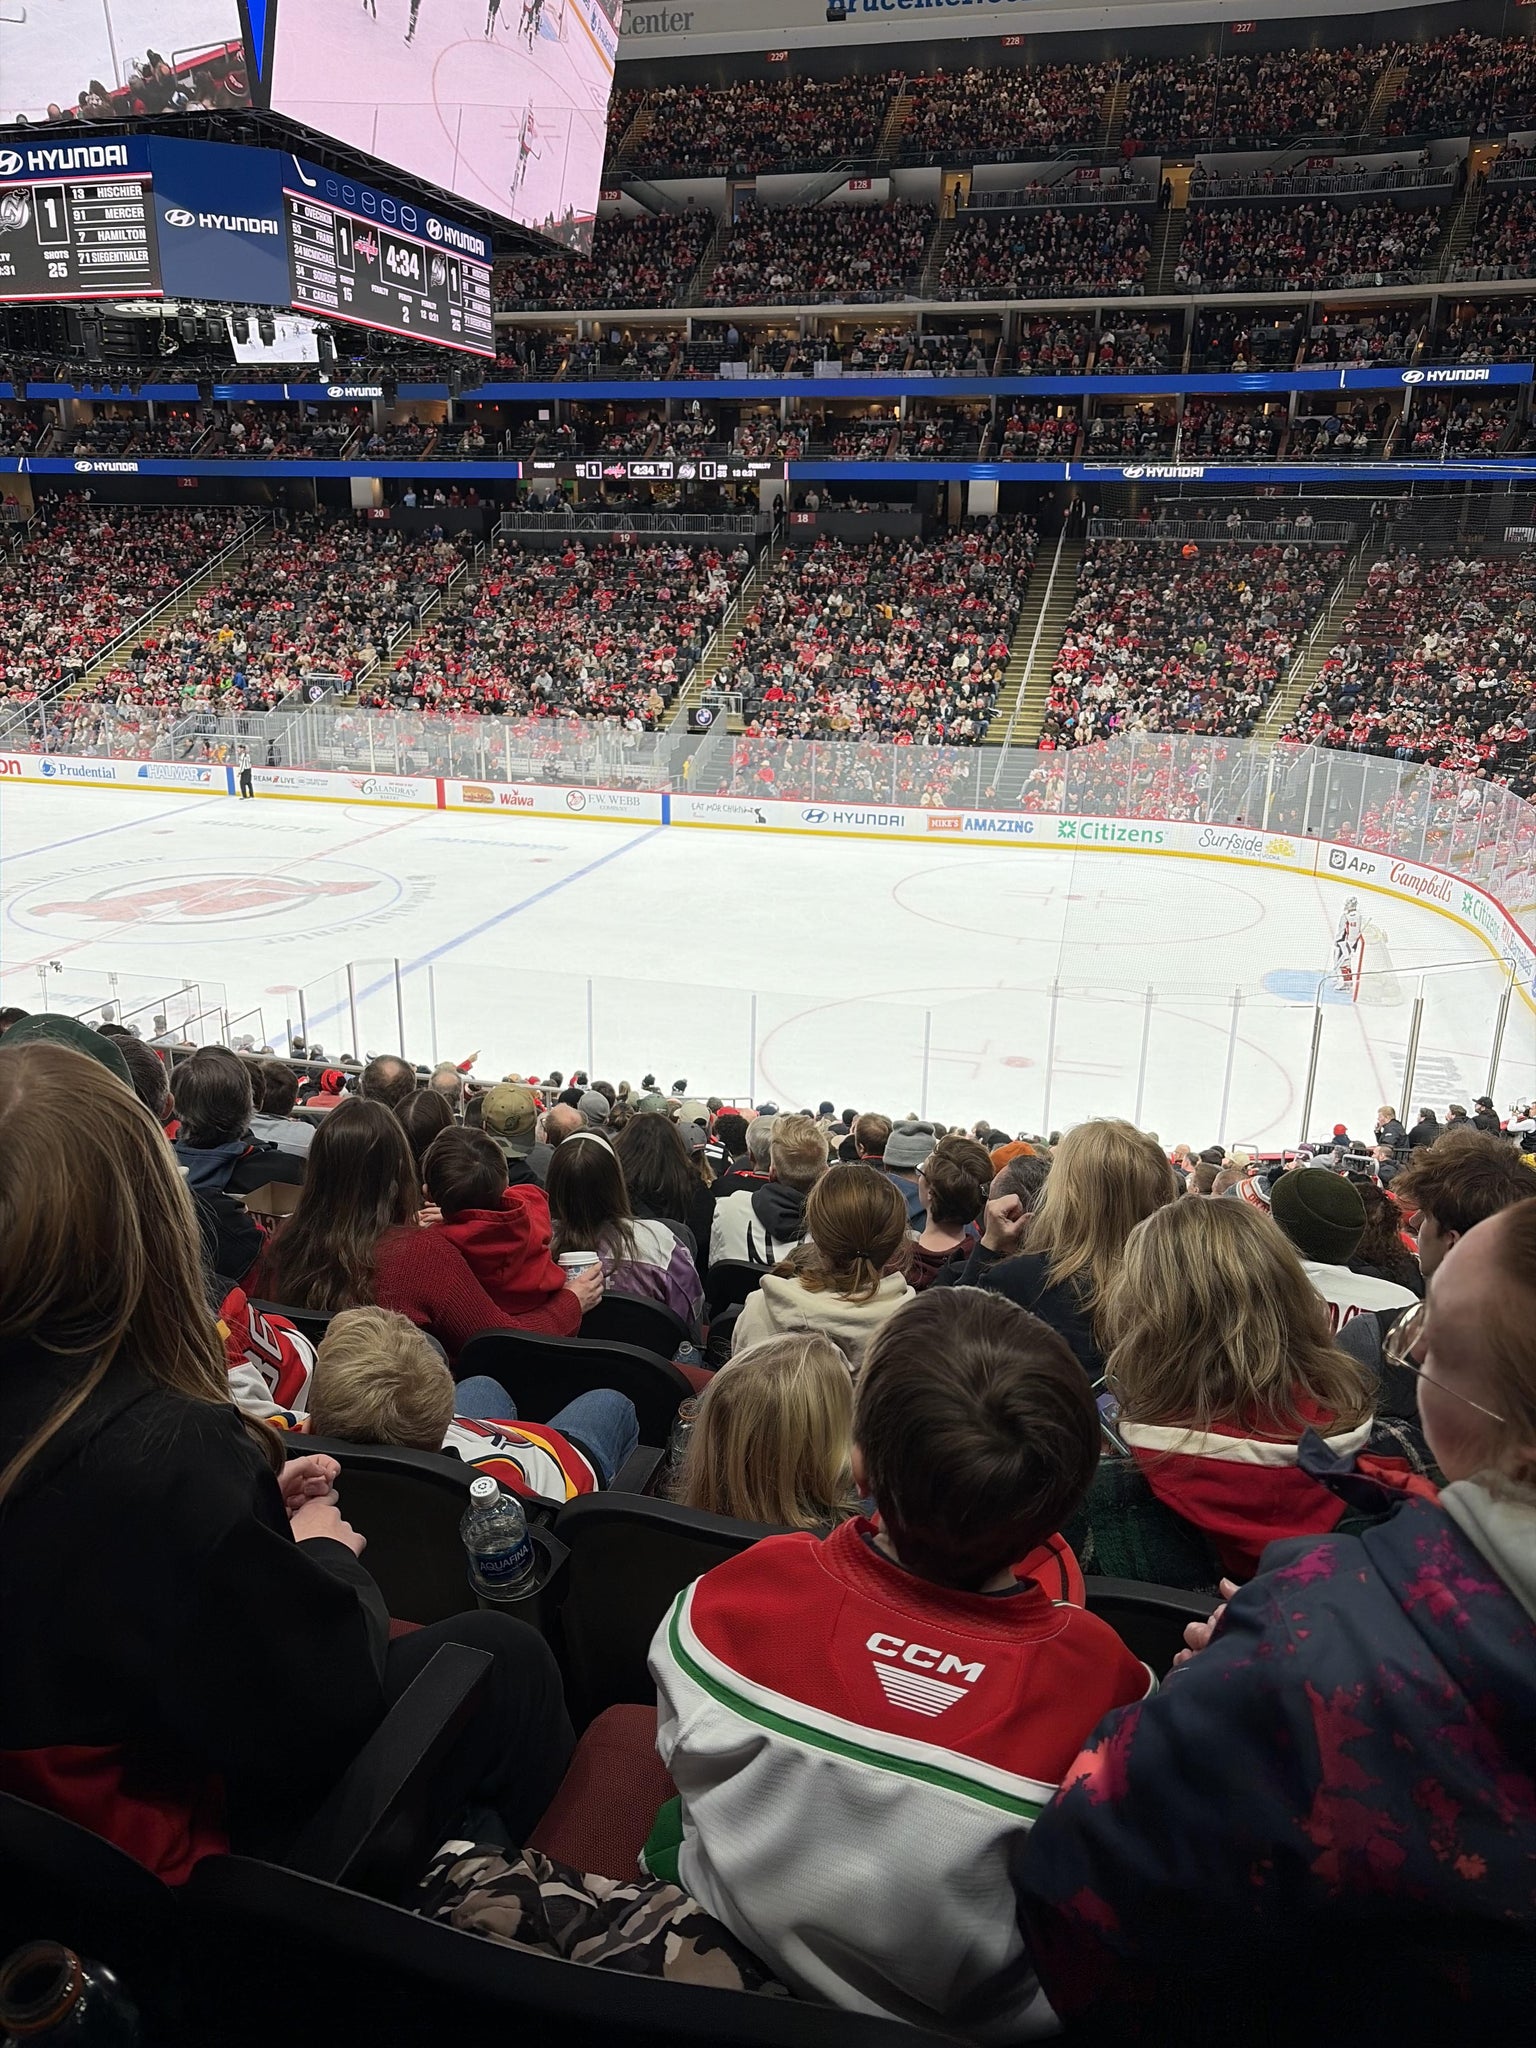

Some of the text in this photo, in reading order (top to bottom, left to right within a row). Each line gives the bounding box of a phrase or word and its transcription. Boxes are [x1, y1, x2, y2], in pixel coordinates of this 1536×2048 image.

[1236, 23, 1251, 32] 227
[1005, 36, 1020, 45] 228
[770, 53, 784, 61] 229
[28, 145, 128, 171] HYUNDAI
[1081, 169, 1095, 178] 127
[854, 180, 867, 189] 128
[72, 186, 142, 199] 13 HISCHIER
[604, 191, 618, 199] 129
[44, 198, 57, 228] 1
[73, 207, 144, 221] 91 MERCER
[199, 213, 278, 235] HYUNDAI
[292, 223, 301, 234] 53
[78, 228, 146, 242] 7 HAMILTON
[340, 227, 348, 255] 1
[444, 225, 485, 257] HYUNDAI
[44, 251, 69, 260] SHOTS
[294, 244, 303, 255] 24
[78, 251, 149, 263] 71 SIEGENTHALER
[386, 245, 420, 280] 4:34
[48, 263, 68, 278] 25
[296, 265, 305, 276] 34
[451, 267, 457, 292] 1
[297, 285, 306, 297] 74
[343, 287, 353, 301] 15
[402, 306, 410, 323] 2
[451, 318, 461, 332] 25
[1427, 369, 1490, 381] HYUNDAI
[94, 462, 139, 472] HYUNDAI
[591, 465, 597, 475] 1
[632, 465, 655, 475] 4:34
[704, 465, 710, 475] 1
[1146, 466, 1205, 478] HYUNDAI
[183, 478, 192, 487] 21
[1264, 487, 1276, 496] 17
[373, 509, 385, 518] 20
[797, 514, 808, 523] 18
[620, 534, 630, 543] 19
[59, 762, 116, 779] Prudential
[148, 765, 200, 782] HALMAR
[500, 792, 534, 807] Wawa
[609, 795, 641, 806] WEBB
[691, 803, 704, 811] EAT
[833, 812, 905, 827] HYUNDAI
[931, 819, 959, 828] MIKE'S
[964, 818, 1034, 834] AMAZING
[1080, 822, 1164, 843] Citizens
[1198, 828, 1263, 852] Surfside
[1389, 860, 1453, 903] Campbell's
[480, 1544, 529, 1571] AQUAFINA
[866, 1632, 986, 1683] CCM
